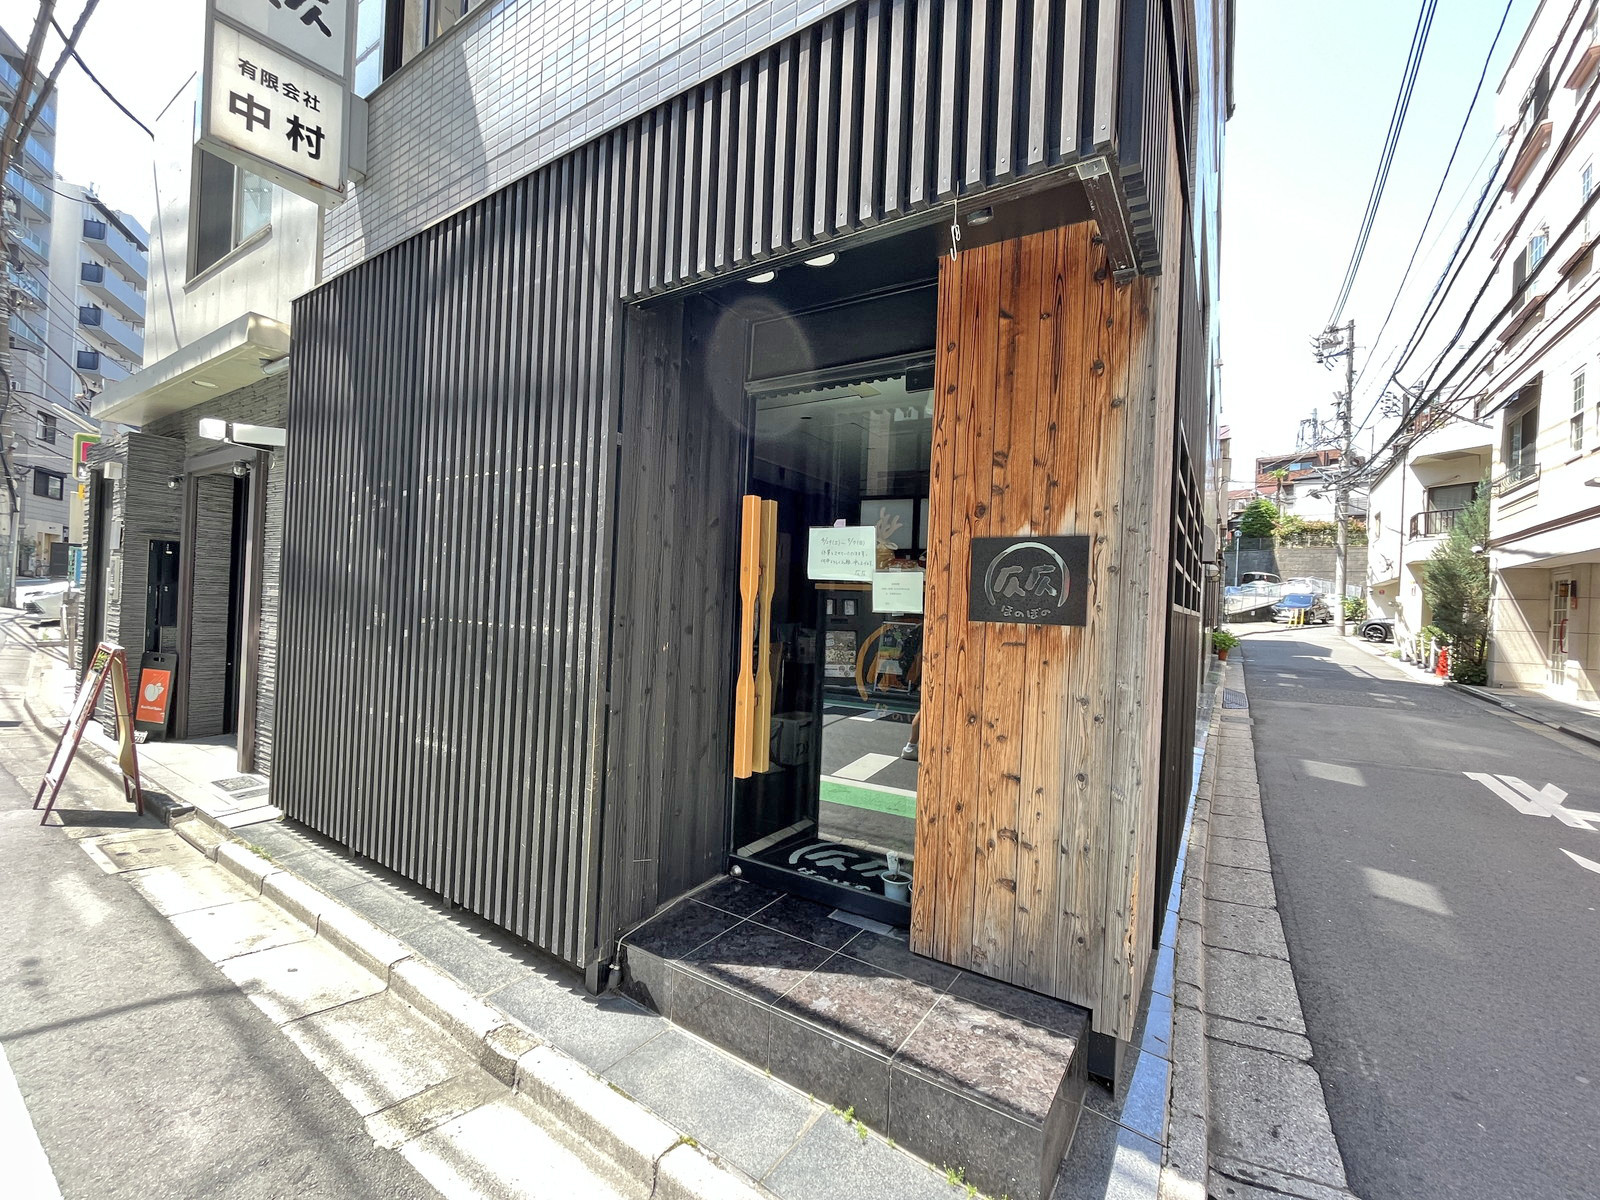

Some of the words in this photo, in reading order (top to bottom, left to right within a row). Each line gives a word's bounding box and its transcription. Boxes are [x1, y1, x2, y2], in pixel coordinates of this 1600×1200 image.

[238, 57, 321, 113] 有限会社
[228, 90, 325, 160] 中村
[1001, 604, 1051, 620] ほのぼの
